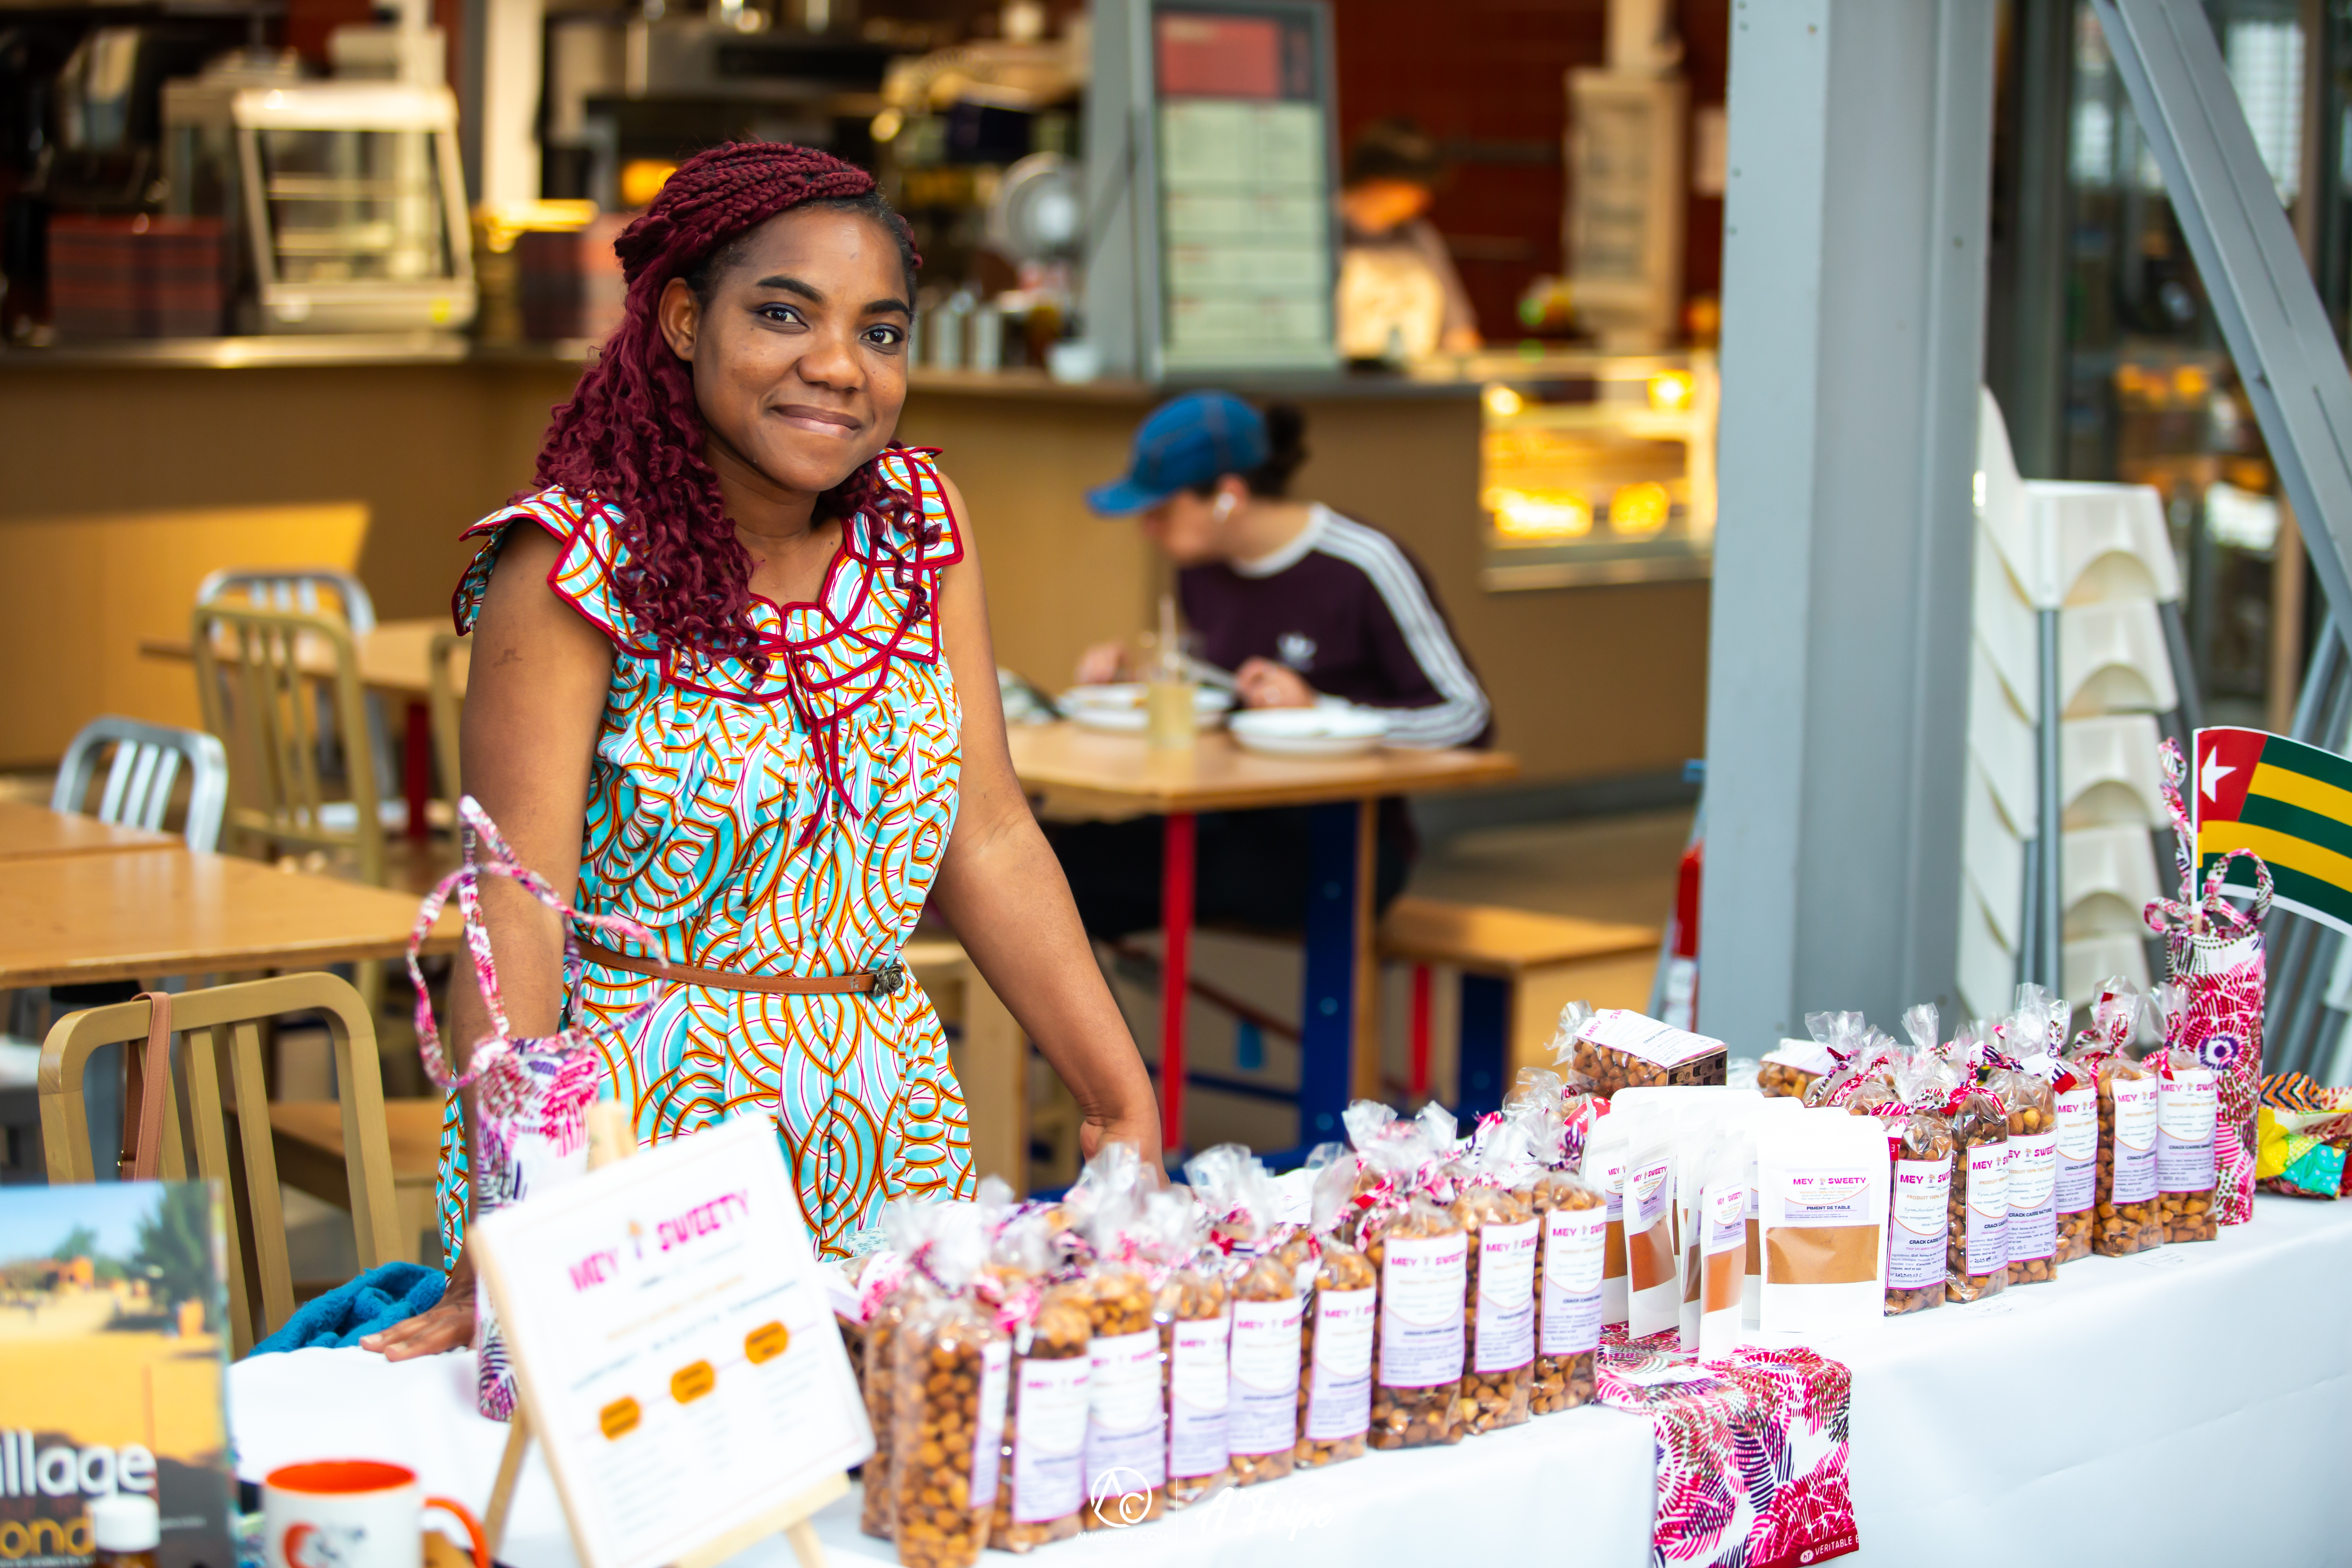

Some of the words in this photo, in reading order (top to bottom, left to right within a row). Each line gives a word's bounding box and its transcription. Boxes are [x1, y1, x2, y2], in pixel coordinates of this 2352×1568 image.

[1586, 1020, 1601, 1036] MEY
[2058, 1105, 2079, 1113] MEY
[2009, 1149, 2020, 1158] EY
[1973, 1160, 1993, 1170] MEY
[1608, 1167, 1619, 1176] MEY
[1648, 1166, 1667, 1177] SWEETY
[1900, 1174, 1924, 1184] MEY
[1728, 1191, 1742, 1202] SWEETY
[1553, 1228, 1577, 1236] MEY
[568, 1247, 619, 1292] MEY
[656, 1188, 750, 1253] SWEETY
[1486, 1243, 1510, 1252] MEY
[1392, 1256, 1417, 1267] MEY
[1815, 1535, 1853, 1556] VERITABLE
